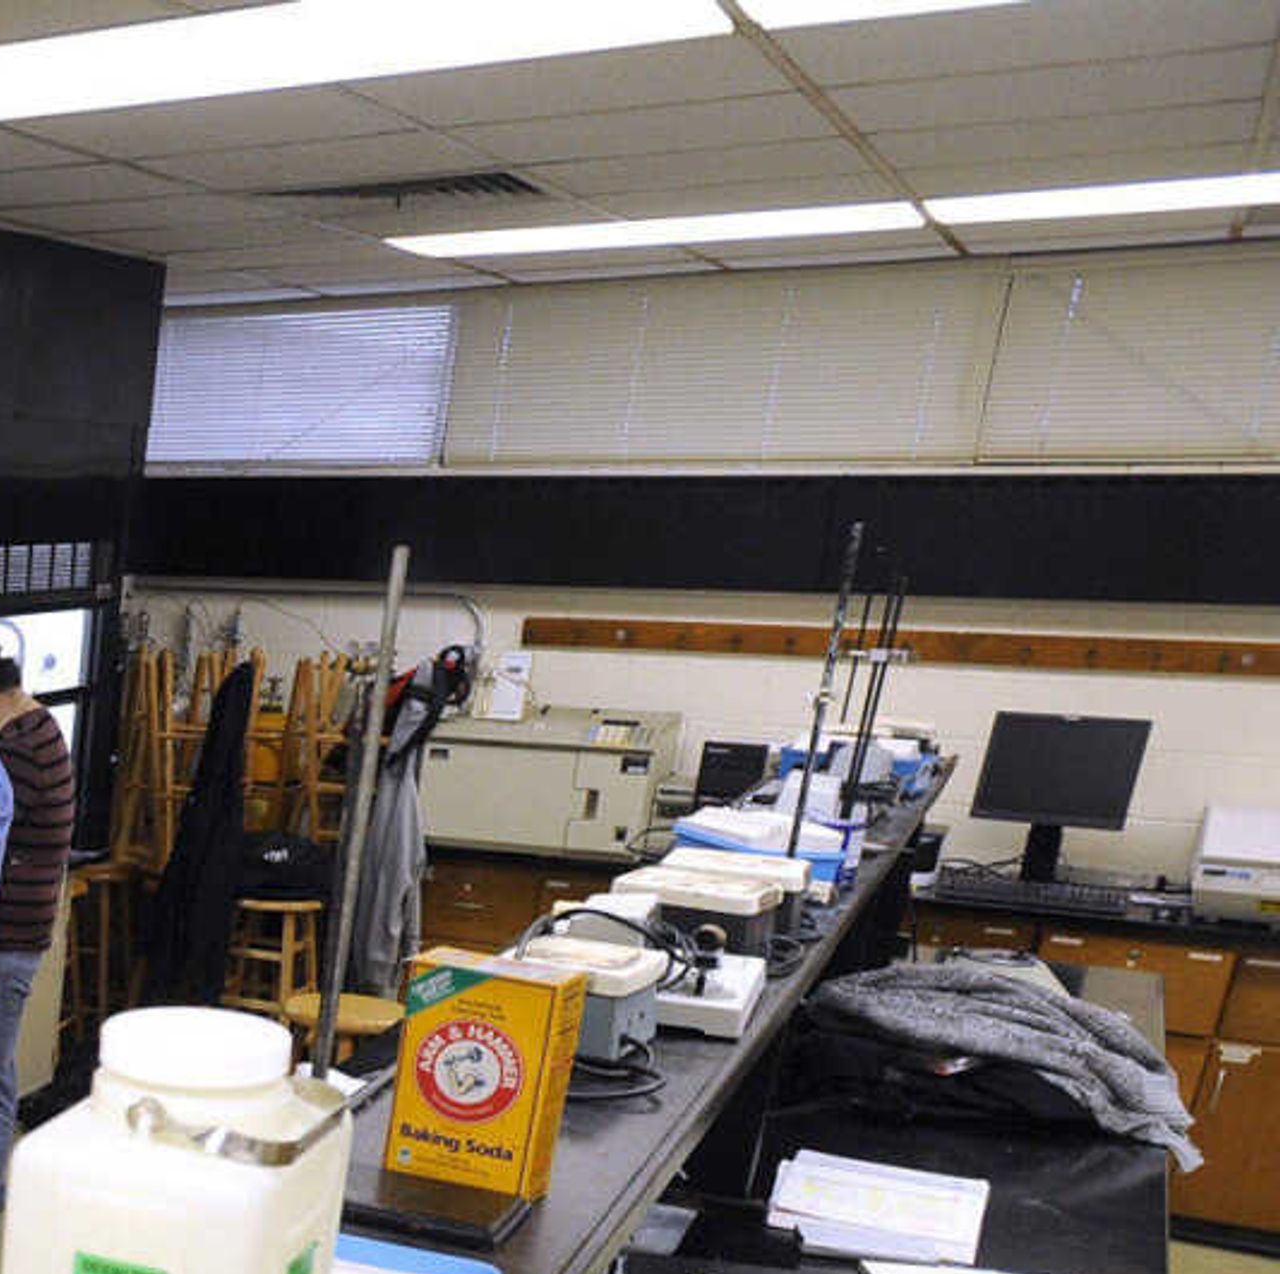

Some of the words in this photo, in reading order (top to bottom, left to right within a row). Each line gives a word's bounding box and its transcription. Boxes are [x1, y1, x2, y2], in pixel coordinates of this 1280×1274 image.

[418, 1034, 446, 1072] ARM
[448, 1023, 464, 1041] &
[468, 1024, 520, 1088] HAMMER
[400, 1122, 461, 1153] Baking
[466, 1140, 514, 1161] Soda
